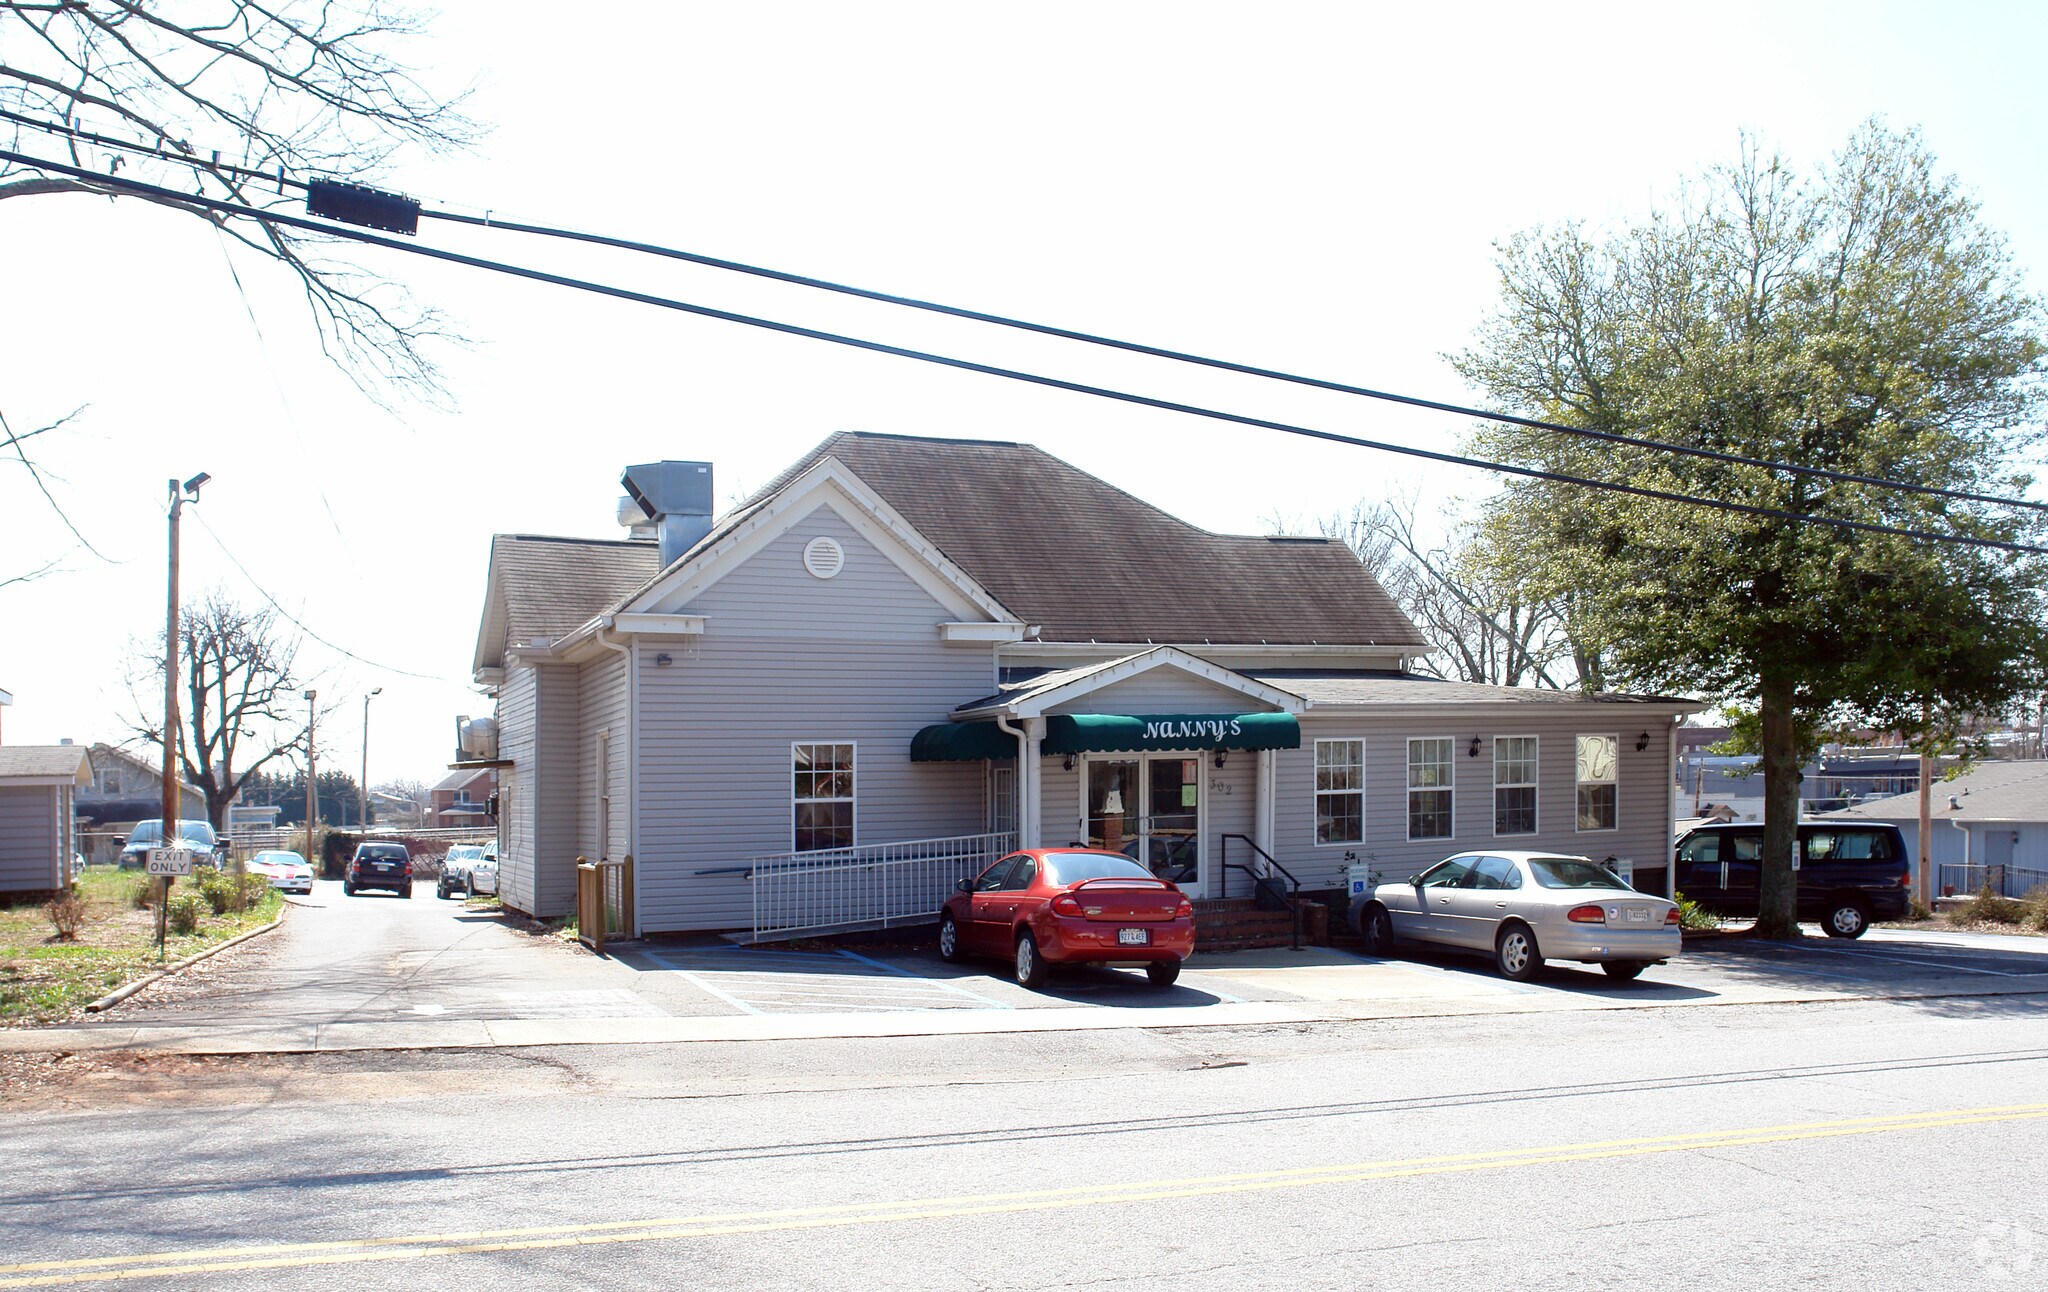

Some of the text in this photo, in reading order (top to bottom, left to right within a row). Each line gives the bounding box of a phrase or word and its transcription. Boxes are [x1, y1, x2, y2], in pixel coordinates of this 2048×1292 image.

[1210, 779, 1232, 796] 302
[155, 851, 184, 861] EXIT
[150, 862, 186, 872] ONLY
